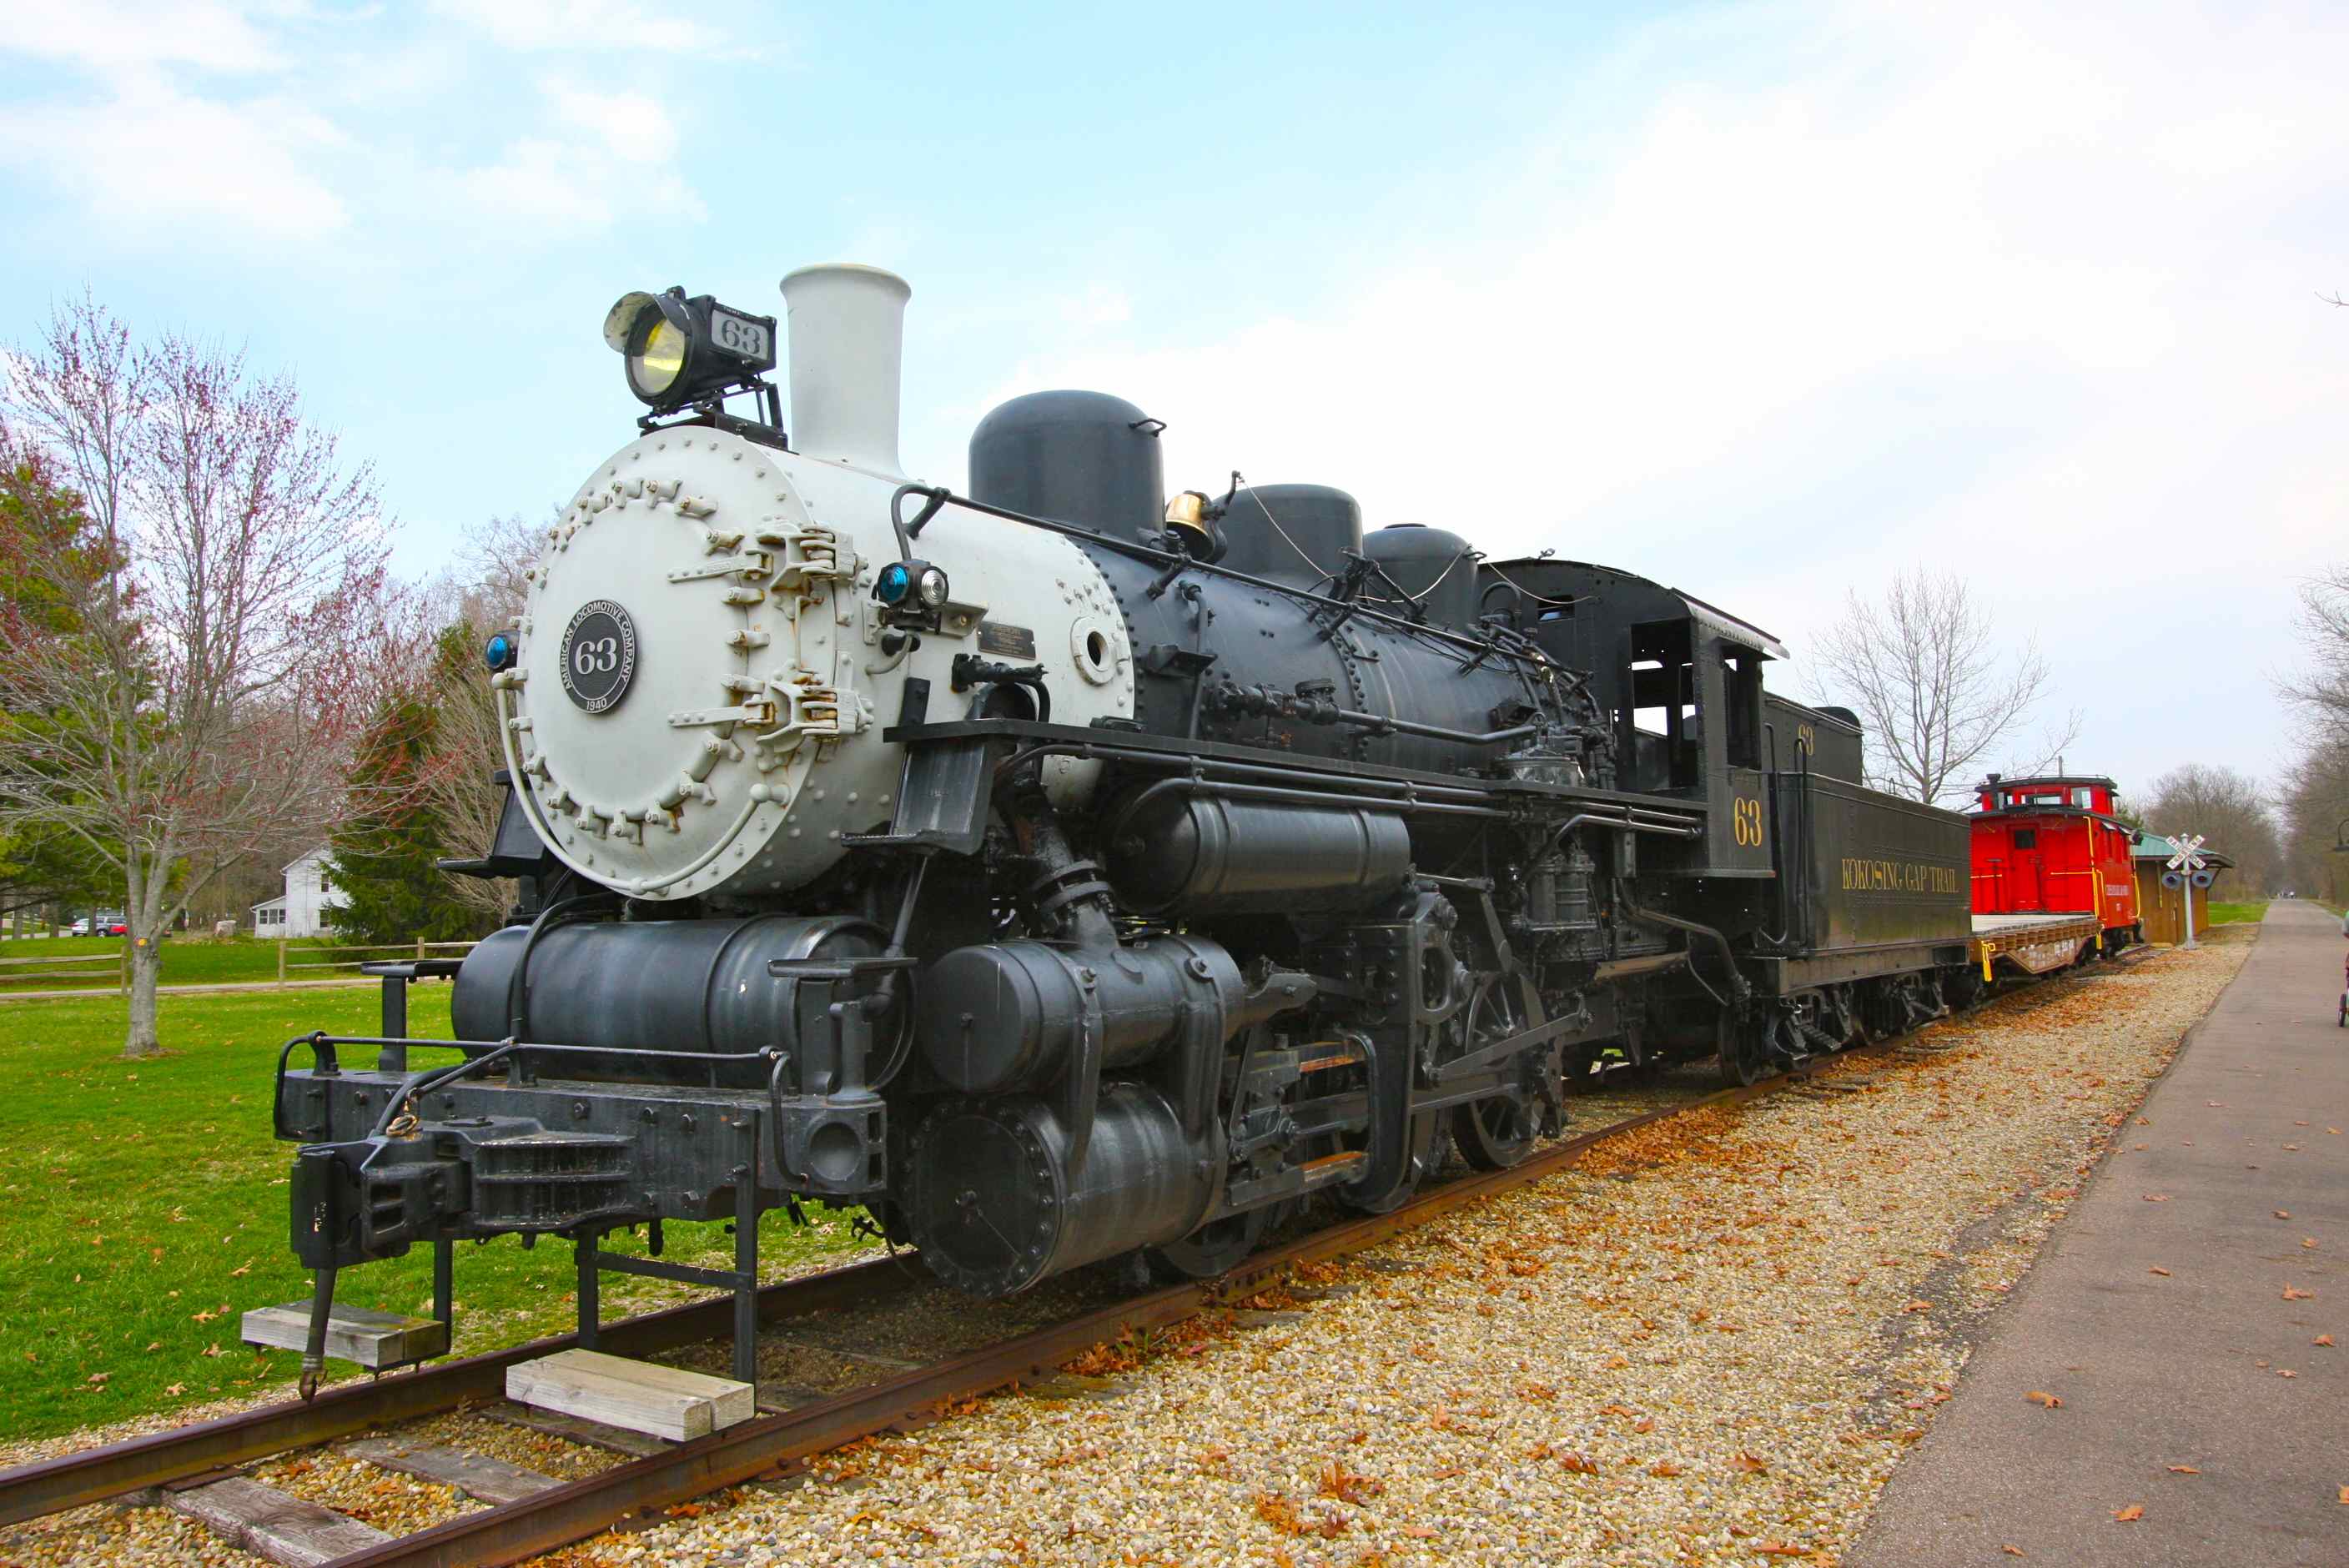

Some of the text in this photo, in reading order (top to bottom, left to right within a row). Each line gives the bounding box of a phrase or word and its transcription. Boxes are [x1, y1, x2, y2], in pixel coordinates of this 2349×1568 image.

[722, 319, 761, 354] 63
[560, 601, 633, 690] AMERICAN LOCOMOTIVE COMPANY
[575, 637, 617, 675] 63
[586, 698, 607, 711] 1940
[1798, 724, 1813, 756] 63
[1734, 797, 1762, 847] 63
[1842, 858, 1959, 893] KOKOSING GAP TRAIL
